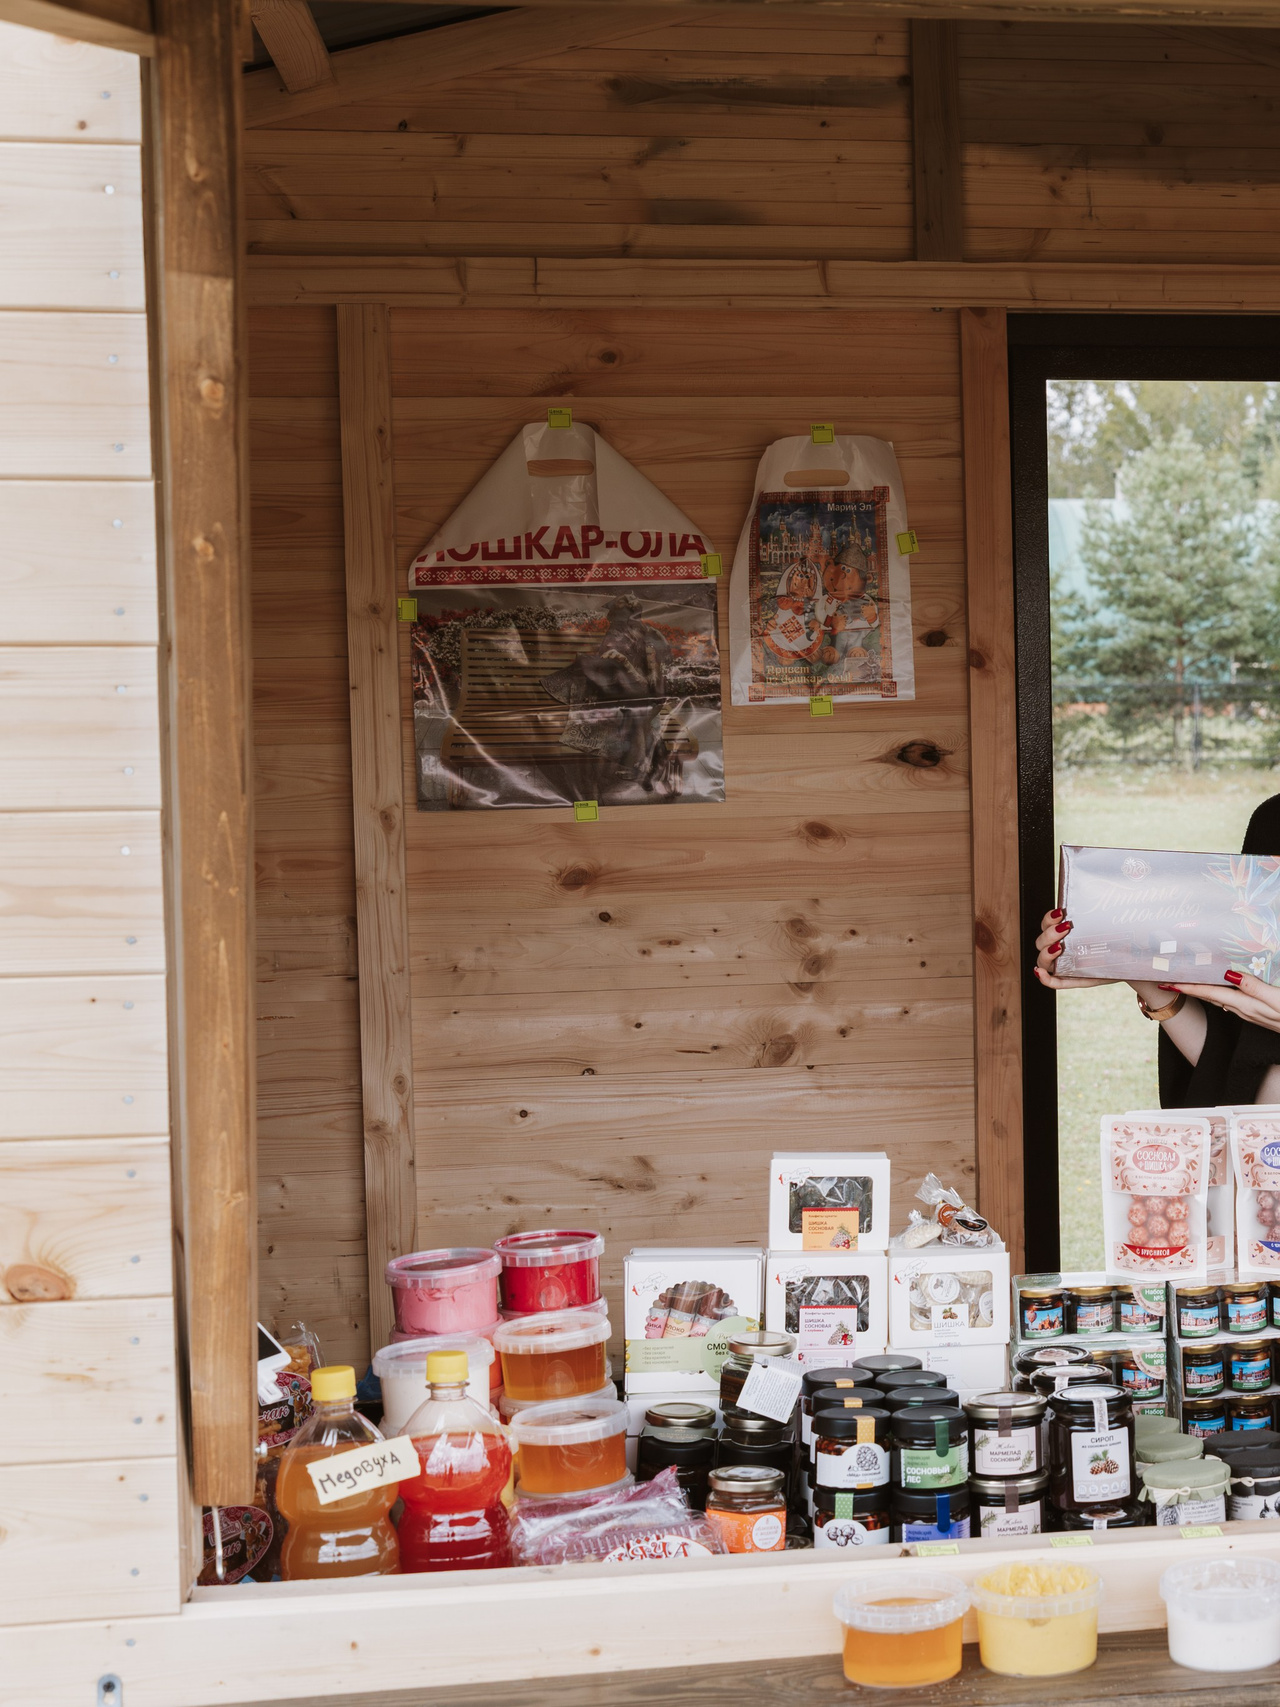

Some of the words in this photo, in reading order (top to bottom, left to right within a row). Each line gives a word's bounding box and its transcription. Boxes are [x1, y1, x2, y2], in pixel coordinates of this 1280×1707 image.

[827, 502, 857, 512] Марий
[859, 502, 872, 512] Эл
[1136, 1150, 1176, 1162] СОСНОВАЯ
[1144, 1159, 1168, 1171] ШИШКА
[1144, 1288, 1164, 1296] Набор
[1090, 1435, 1114, 1444] СИРОП
[906, 1464, 950, 1476] СОСНОВЫЙ
[906, 1475, 922, 1483] ЛЕС
